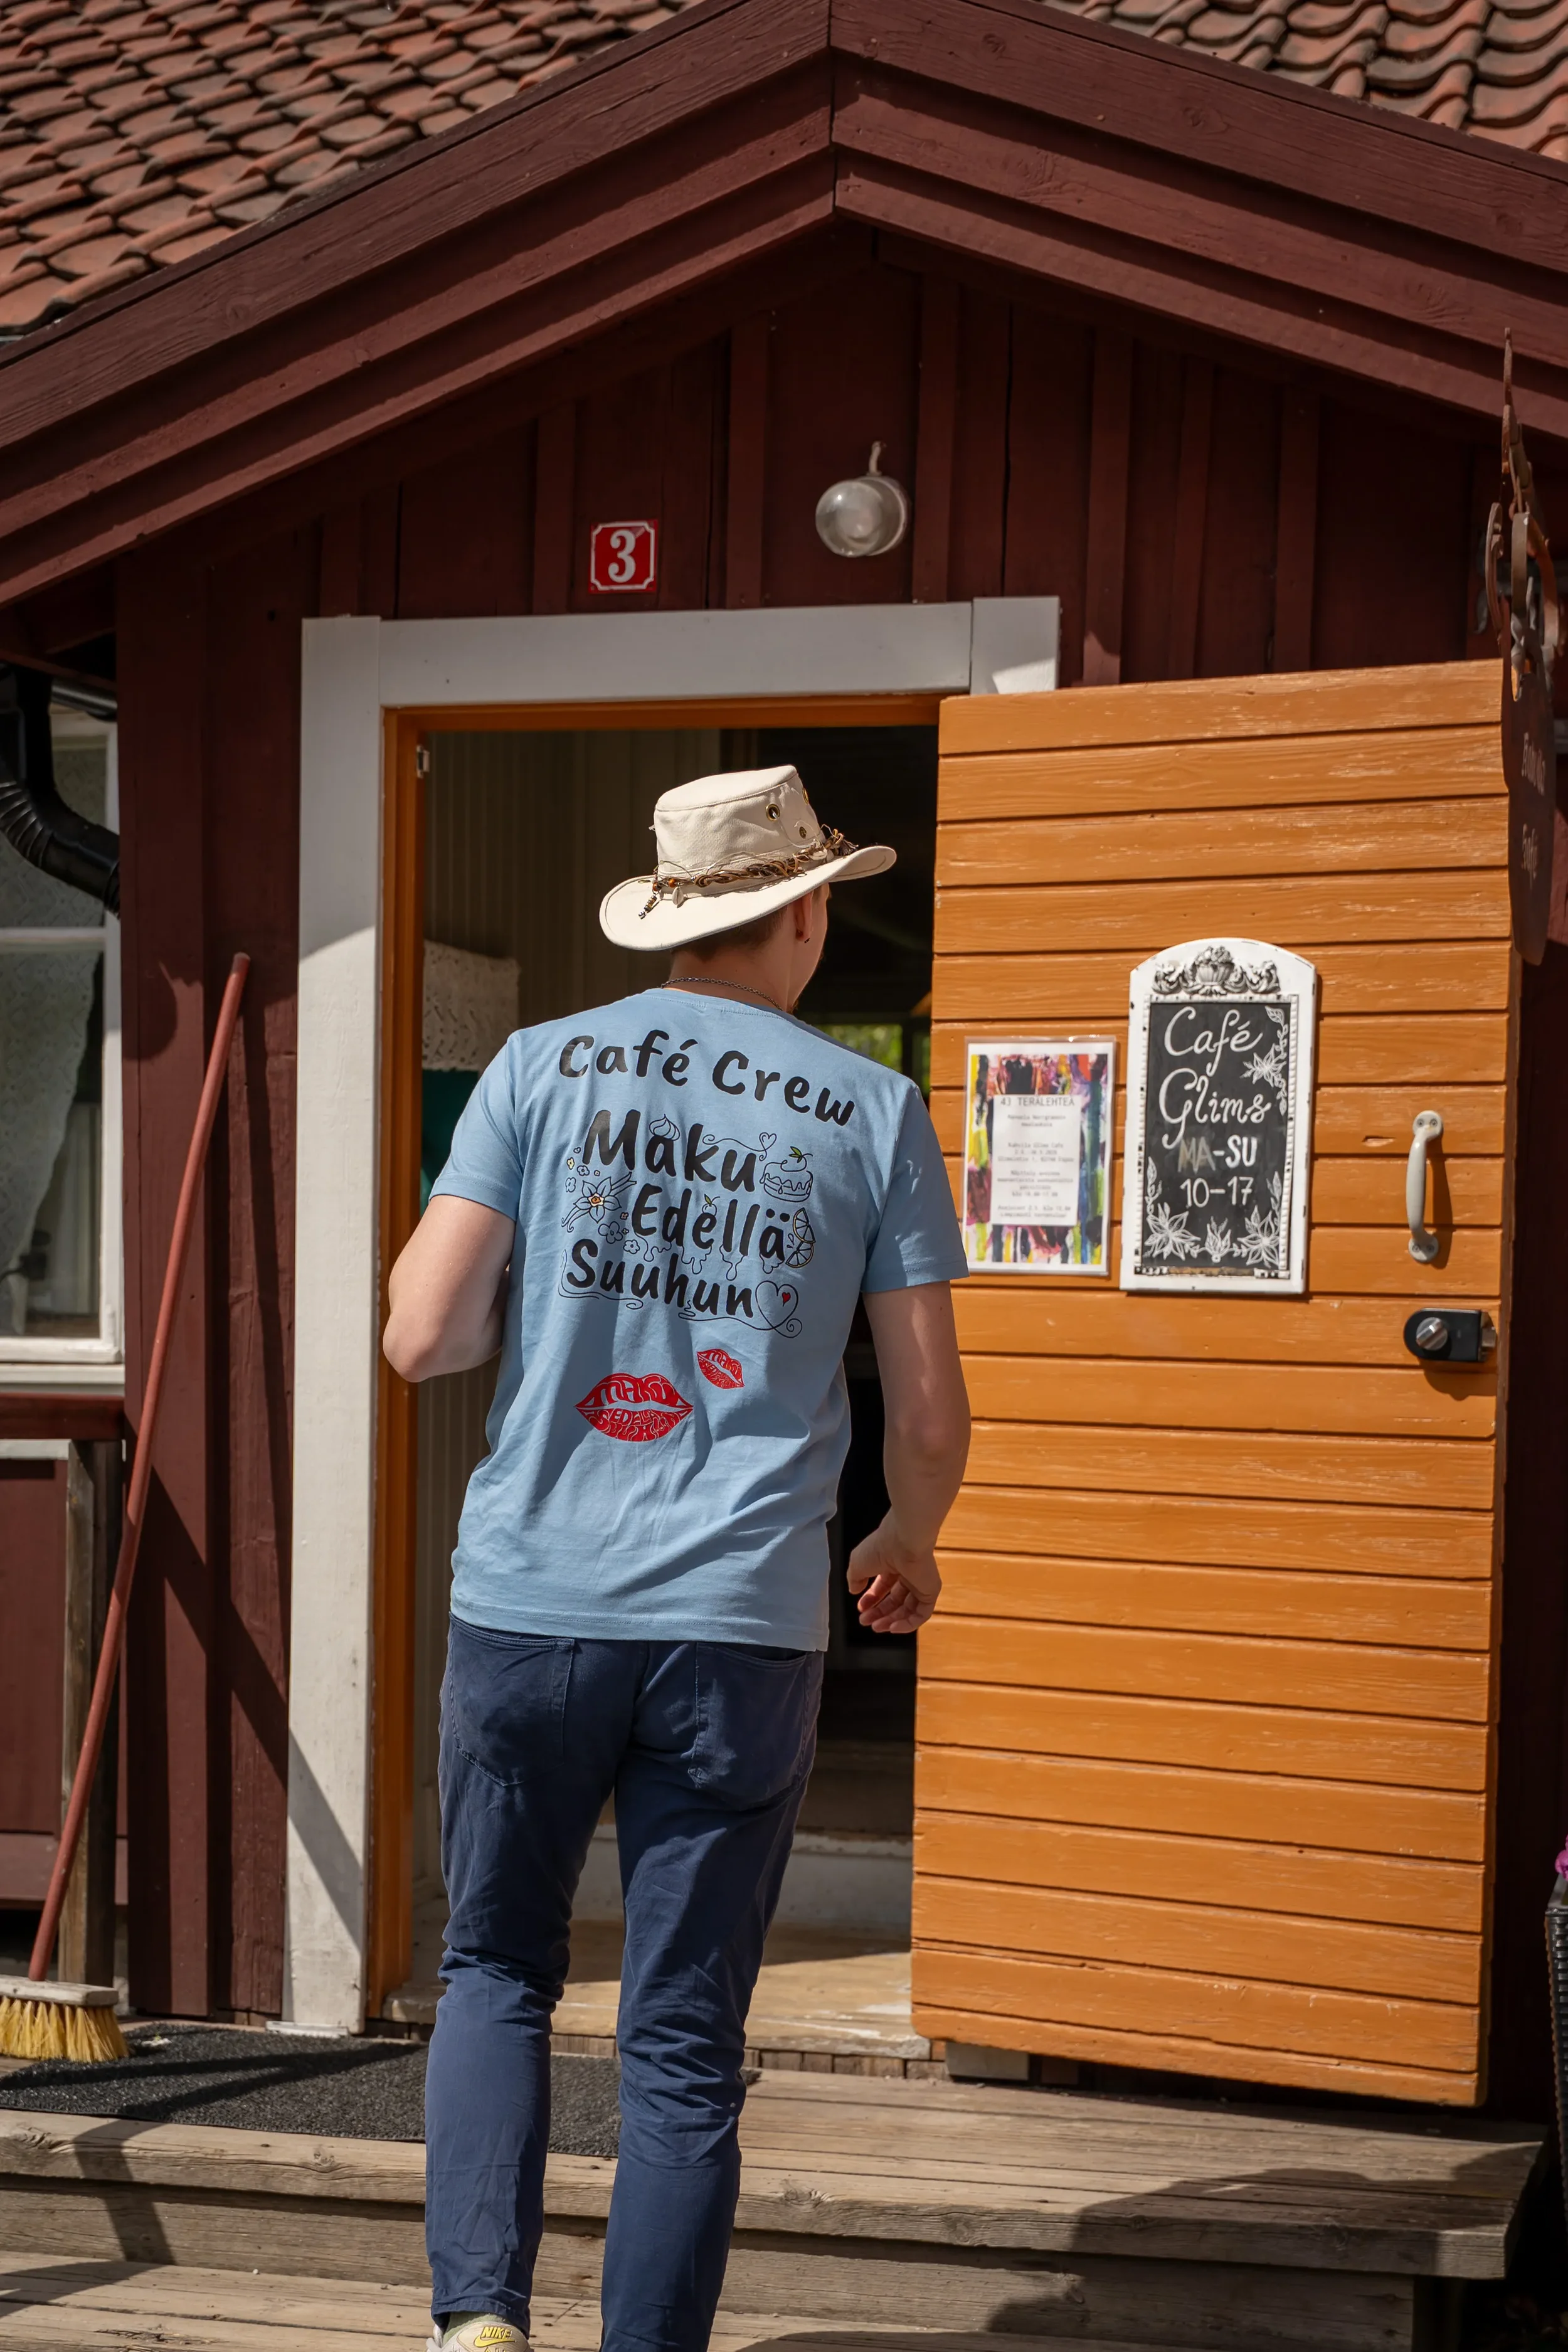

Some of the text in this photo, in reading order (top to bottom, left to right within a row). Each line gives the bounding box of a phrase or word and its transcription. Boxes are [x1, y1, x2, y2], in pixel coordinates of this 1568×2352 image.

[608, 529, 636, 583] 3
[559, 1029, 854, 1126] Café Crew
[1164, 1006, 1263, 1076] Café
[1158, 1067, 1272, 1149] Glims
[581, 1109, 756, 1192] Maku
[631, 1183, 790, 1259] Edellä
[1180, 1175, 1254, 1208] 10-17
[566, 1239, 753, 1318] Suuhun
[480, 2326, 511, 2339] NIKE
